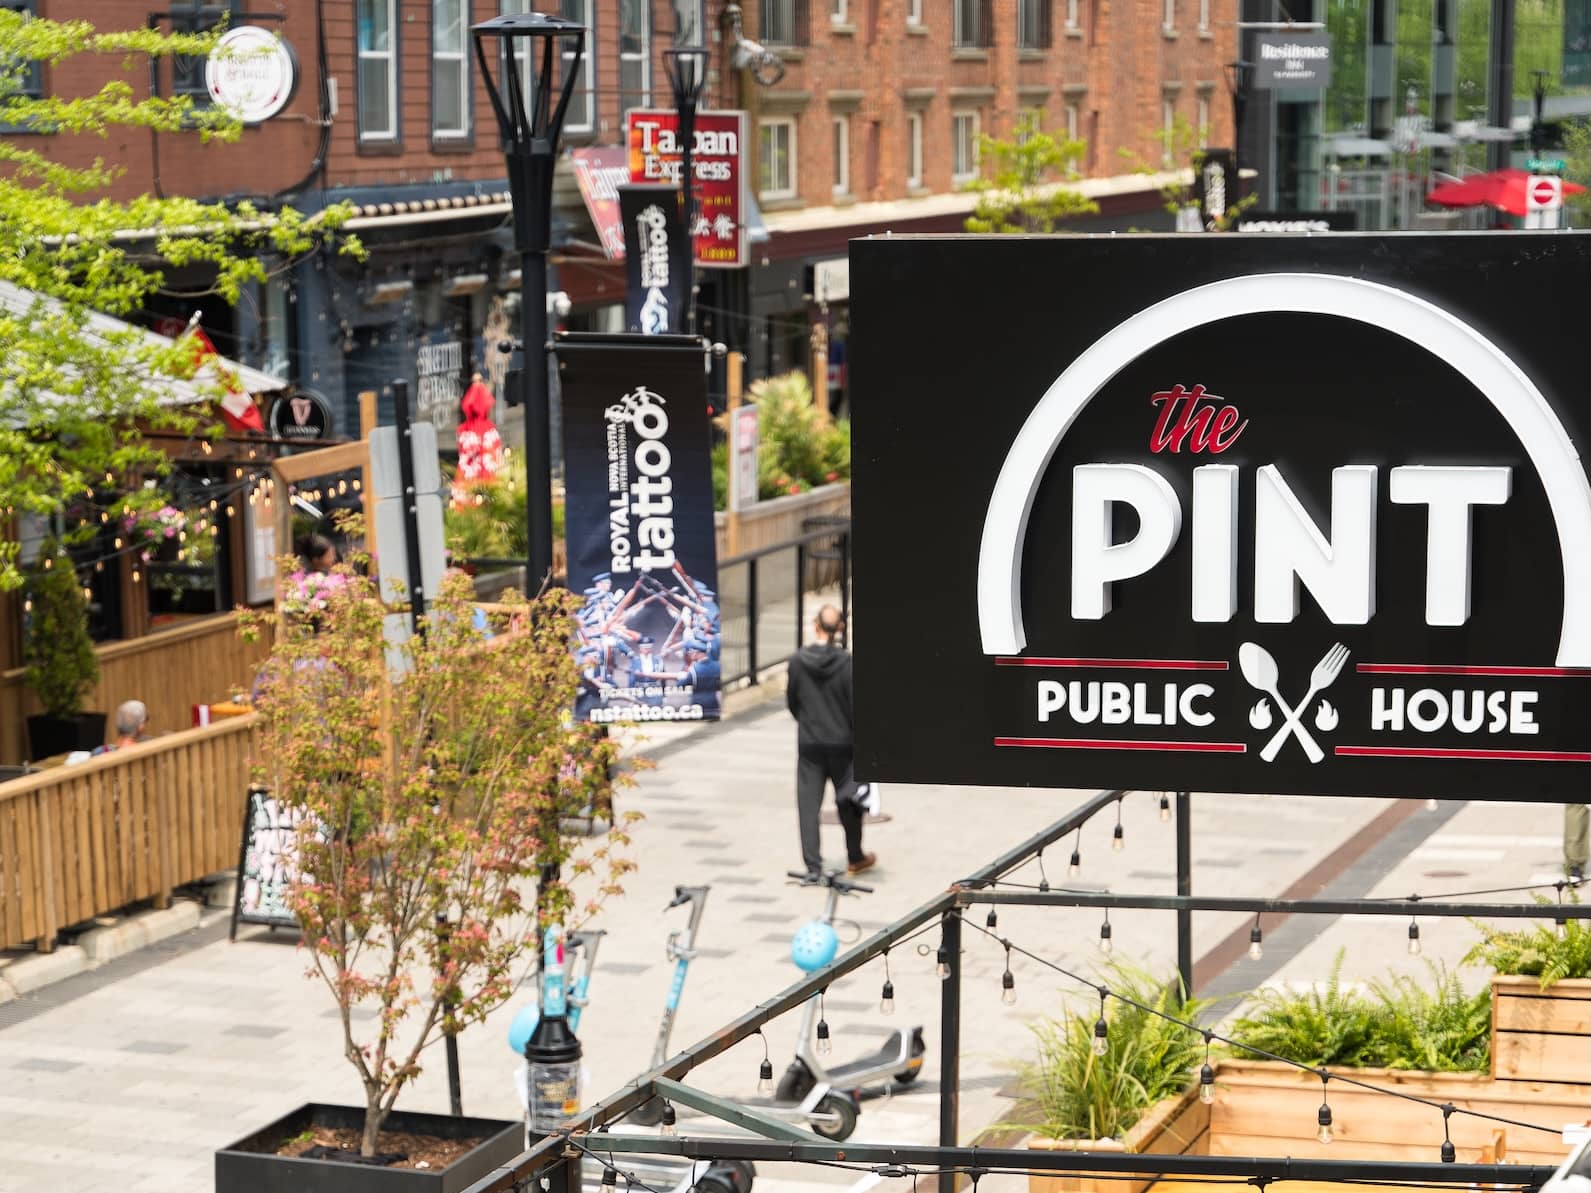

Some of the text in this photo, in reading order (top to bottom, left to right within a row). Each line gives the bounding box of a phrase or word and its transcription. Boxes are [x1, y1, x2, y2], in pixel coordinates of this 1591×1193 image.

[1149, 384, 1249, 454] the
[618, 422, 629, 492] INTERNATIONAL
[631, 402, 675, 571] tattoo
[607, 423, 631, 573] ROYAL NOVA SCOTIA
[1070, 463, 1513, 627] PINT
[590, 704, 703, 722] nstattoo.ca
[599, 685, 693, 699] TICKETS ON SALE
[1038, 680, 1539, 734] PUBLIC HOUSE
